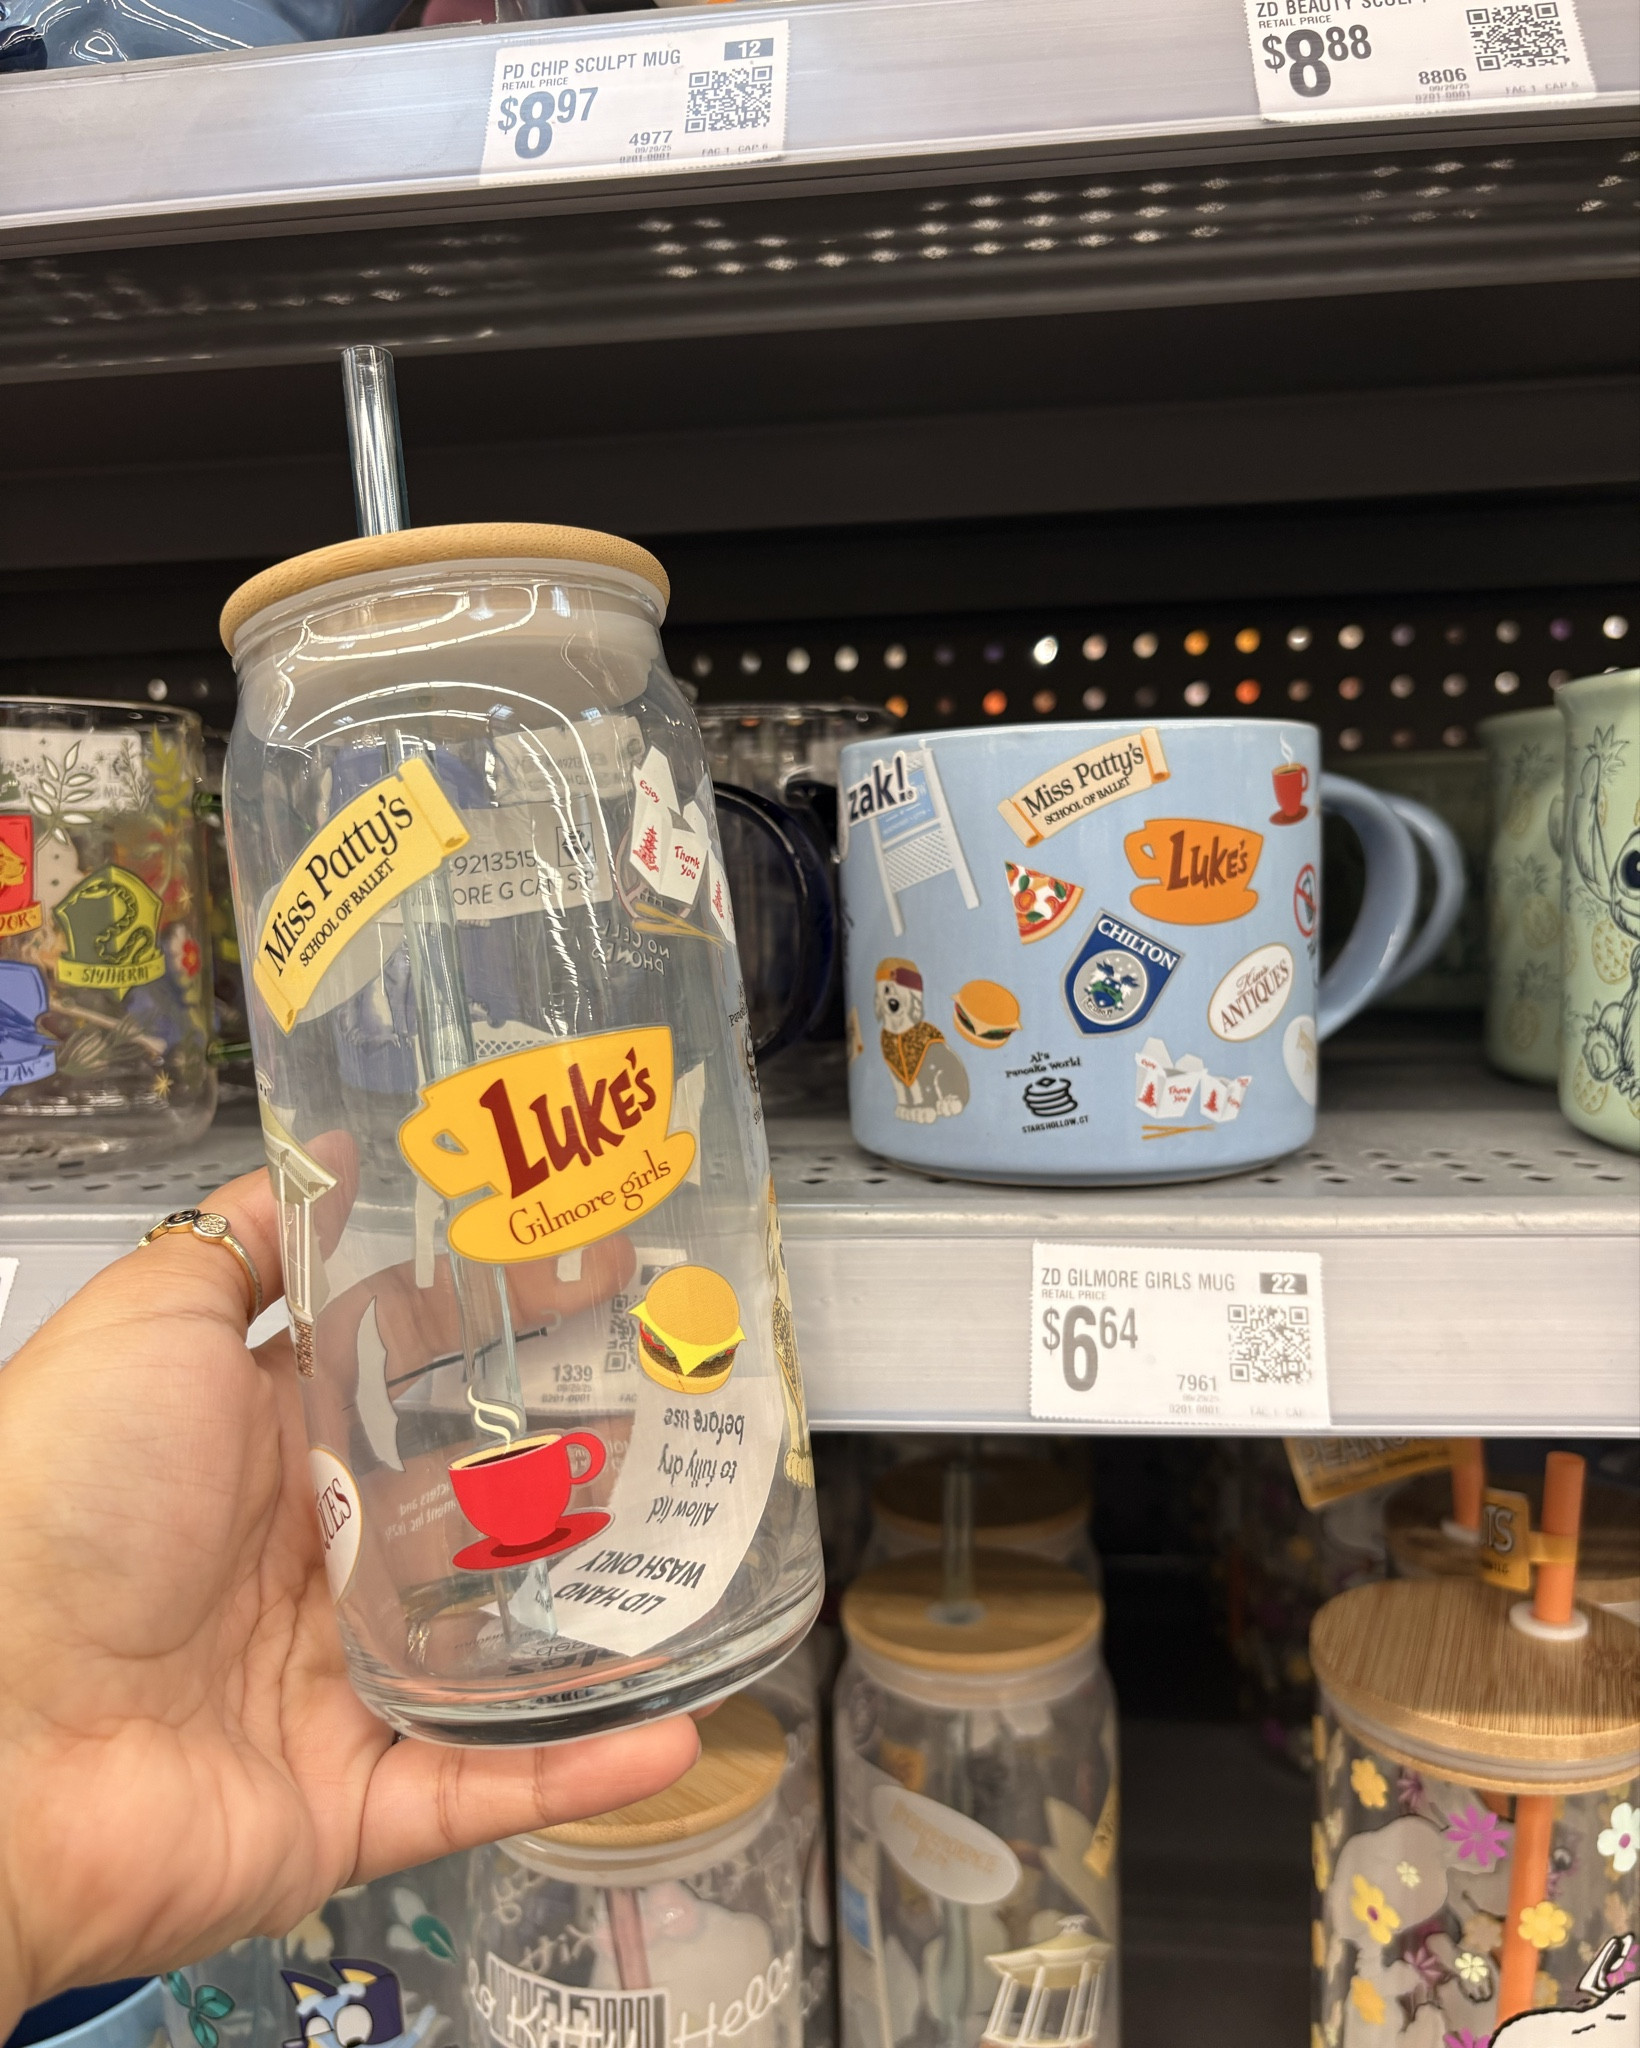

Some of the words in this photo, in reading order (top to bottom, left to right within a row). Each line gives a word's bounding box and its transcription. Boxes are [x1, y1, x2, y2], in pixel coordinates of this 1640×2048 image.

[1256, 2, 1278, 17] ZD
[1258, 19, 1296, 29] RETAIL
[1299, 15, 1332, 25] PRICE
[738, 41, 761, 58] 12
[503, 64, 524, 80] PD
[530, 60, 569, 77] CHIP
[575, 53, 637, 73] SCULPT
[643, 49, 681, 67] MUG
[1418, 68, 1467, 85] 8806
[502, 80, 535, 91] RETAIL
[539, 77, 568, 88] PRICE
[629, 130, 672, 146] 4977
[639, 780, 660, 804] Enjoy
[1022, 778, 1074, 817] Miss
[1072, 743, 1144, 788] Patty's
[1044, 801, 1083, 825] SCHOOL
[1082, 794, 1096, 806] OF
[1096, 776, 1130, 799] BALLET
[674, 845, 700, 869] Thank
[264, 890, 316, 977] Miss
[305, 794, 413, 901] Patty's
[299, 918, 339, 967] SCHOOL
[336, 898, 354, 921] OF
[350, 858, 395, 906] BALLET
[1097, 919, 1178, 971] CHILTON
[1221, 959, 1289, 1033] ANTIQUES
[509, 1190, 617, 1245] Gilmore
[620, 1150, 672, 1211] girls
[1041, 1268, 1061, 1286] ZD
[1068, 1269, 1139, 1288] GILMORE
[1145, 1272, 1192, 1290] GIRLS
[1198, 1274, 1236, 1291] MUG
[1271, 1274, 1296, 1293] 22
[1042, 1289, 1076, 1300] RETAIL
[1078, 1290, 1107, 1301] PRICE
[553, 1363, 592, 1382] 1339
[1177, 1374, 1217, 1391] 7961
[664, 1408, 689, 1426] use
[694, 1414, 745, 1445] before
[658, 1443, 683, 1487] dry
[685, 1448, 715, 1487] fully
[721, 1461, 738, 1484] to
[646, 1496, 673, 1524] lid
[672, 1501, 719, 1527] Allow
[577, 1549, 643, 1575] ONLY
[637, 1555, 706, 1589] WASH
[554, 1582, 625, 1607] HAND
[618, 1592, 667, 1614] LID
